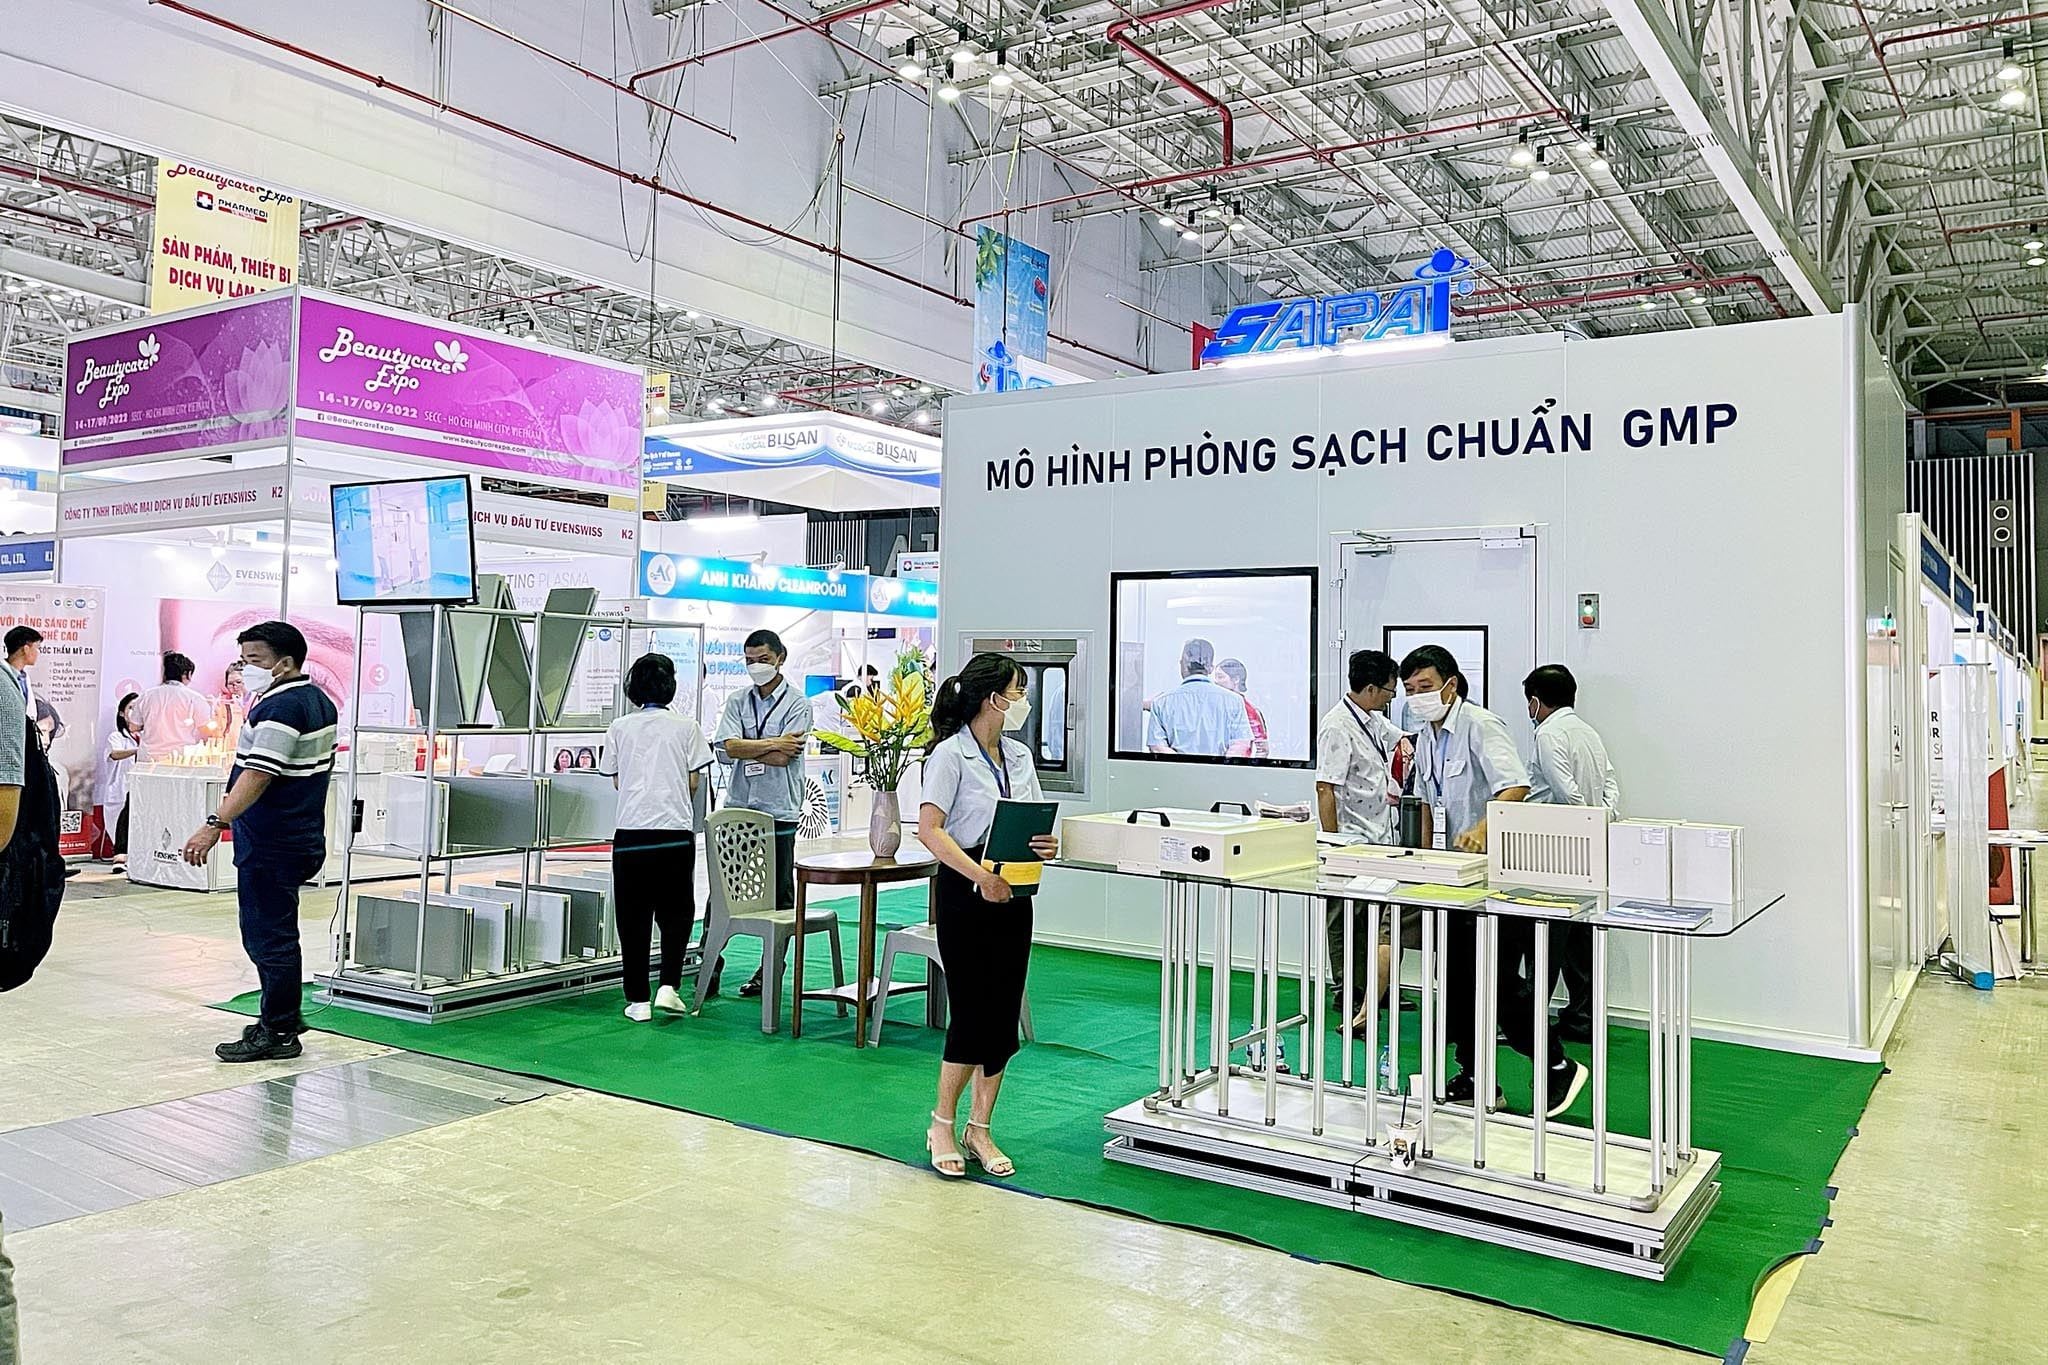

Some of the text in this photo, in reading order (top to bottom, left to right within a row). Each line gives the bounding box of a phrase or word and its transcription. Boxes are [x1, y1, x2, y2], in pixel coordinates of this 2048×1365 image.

[241, 257, 275, 280] THIẾT
[169, 267, 202, 290] DỊCH
[206, 276, 224, 299] VỤ
[319, 327, 452, 374] Beautycare
[76, 358, 150, 395] Beautycare
[364, 364, 420, 395] Expo
[98, 379, 130, 409] Expo
[319, 391, 418, 419] 14-17/09/2022
[424, 411, 442, 423] SECC
[987, 398, 1738, 491] MÔ HÌNH PHÒNG SẠCH CHUẨN GMP
[83, 508, 91, 519] TY
[214, 490, 257, 506] EVENSWISS
[271, 486, 283, 499] K2
[473, 511, 491, 525] ỊCH
[494, 513, 507, 528] VỤ
[550, 521, 603, 538] EVENSWISS
[621, 529, 633, 540] K2
[236, 569, 282, 582] EVENSWIS
[701, 570, 729, 587] ANH
[777, 578, 846, 598] CLEANROOM
[61, 631, 79, 641] CAO
[374, 666, 385, 682] 3
